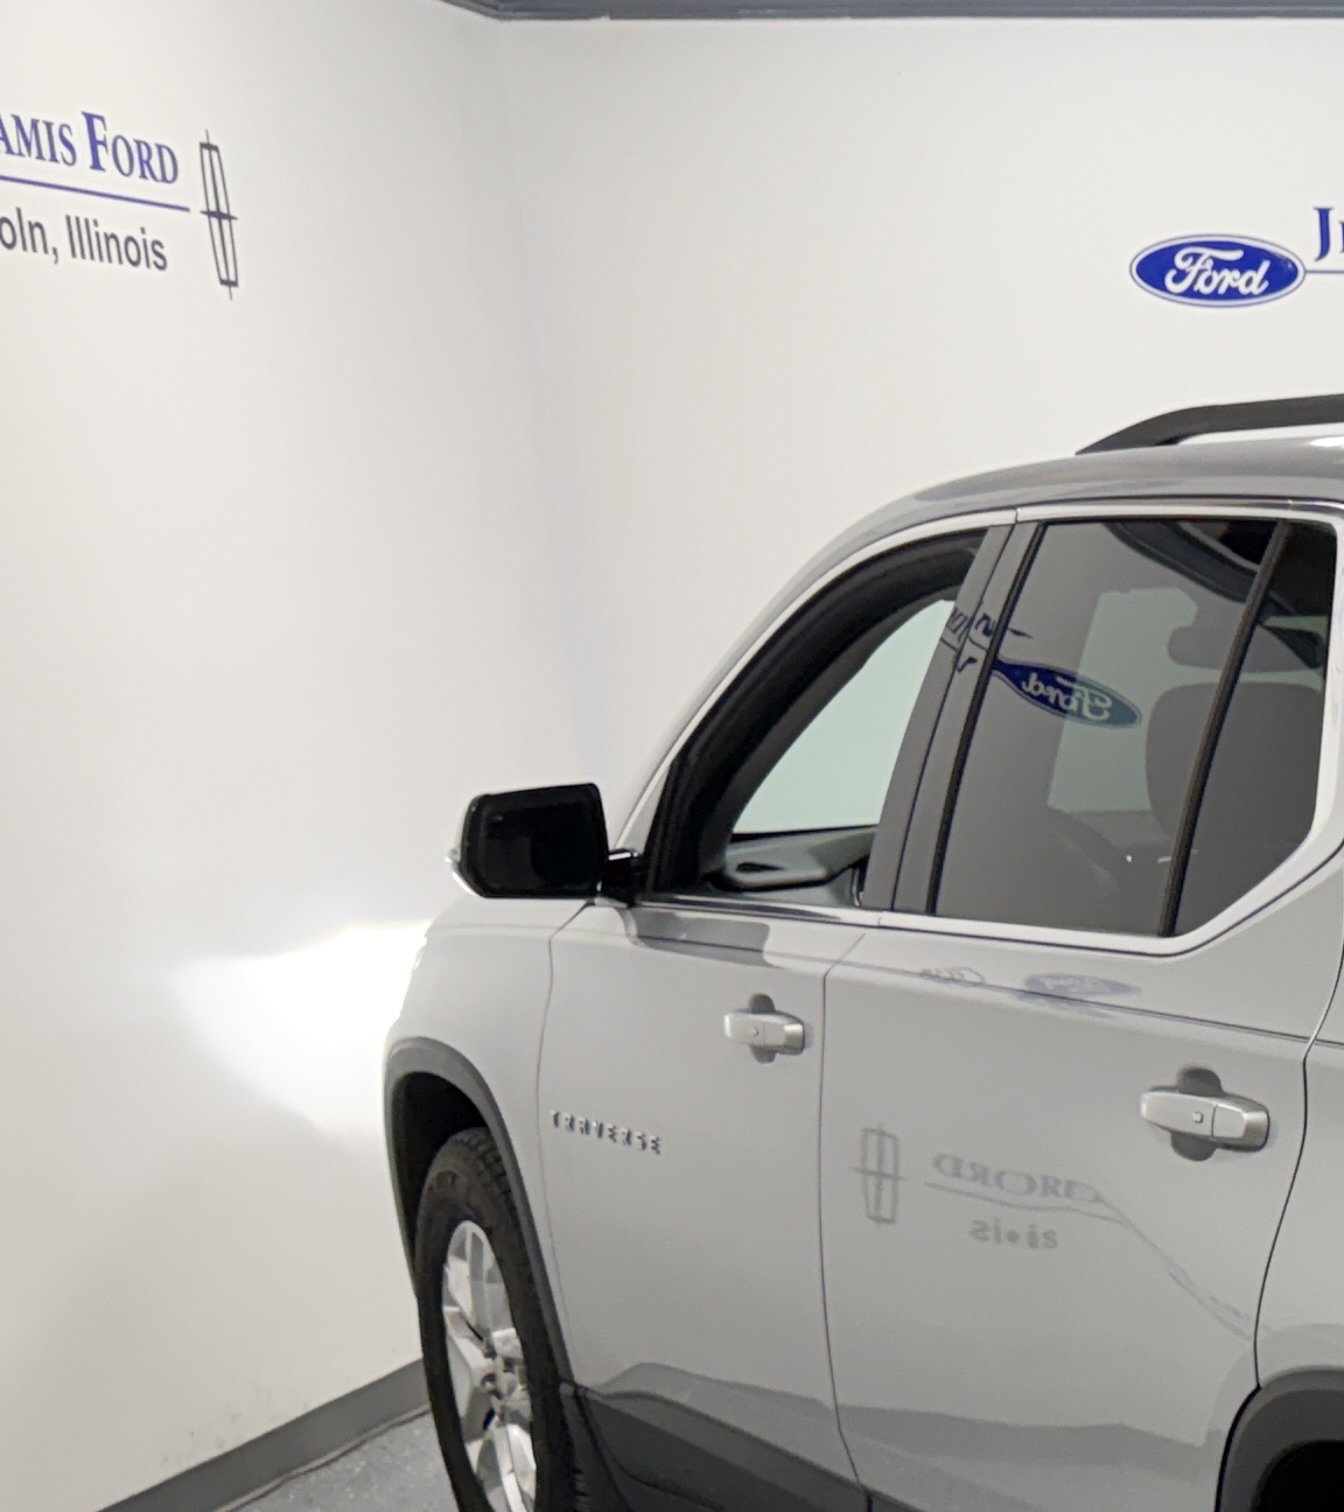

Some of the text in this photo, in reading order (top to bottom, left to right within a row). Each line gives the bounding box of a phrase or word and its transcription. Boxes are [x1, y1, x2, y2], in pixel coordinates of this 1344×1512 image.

[81, 110, 179, 185] FORD
[65, 214, 168, 271] Illinois
[1163, 248, 1270, 296] Ford
